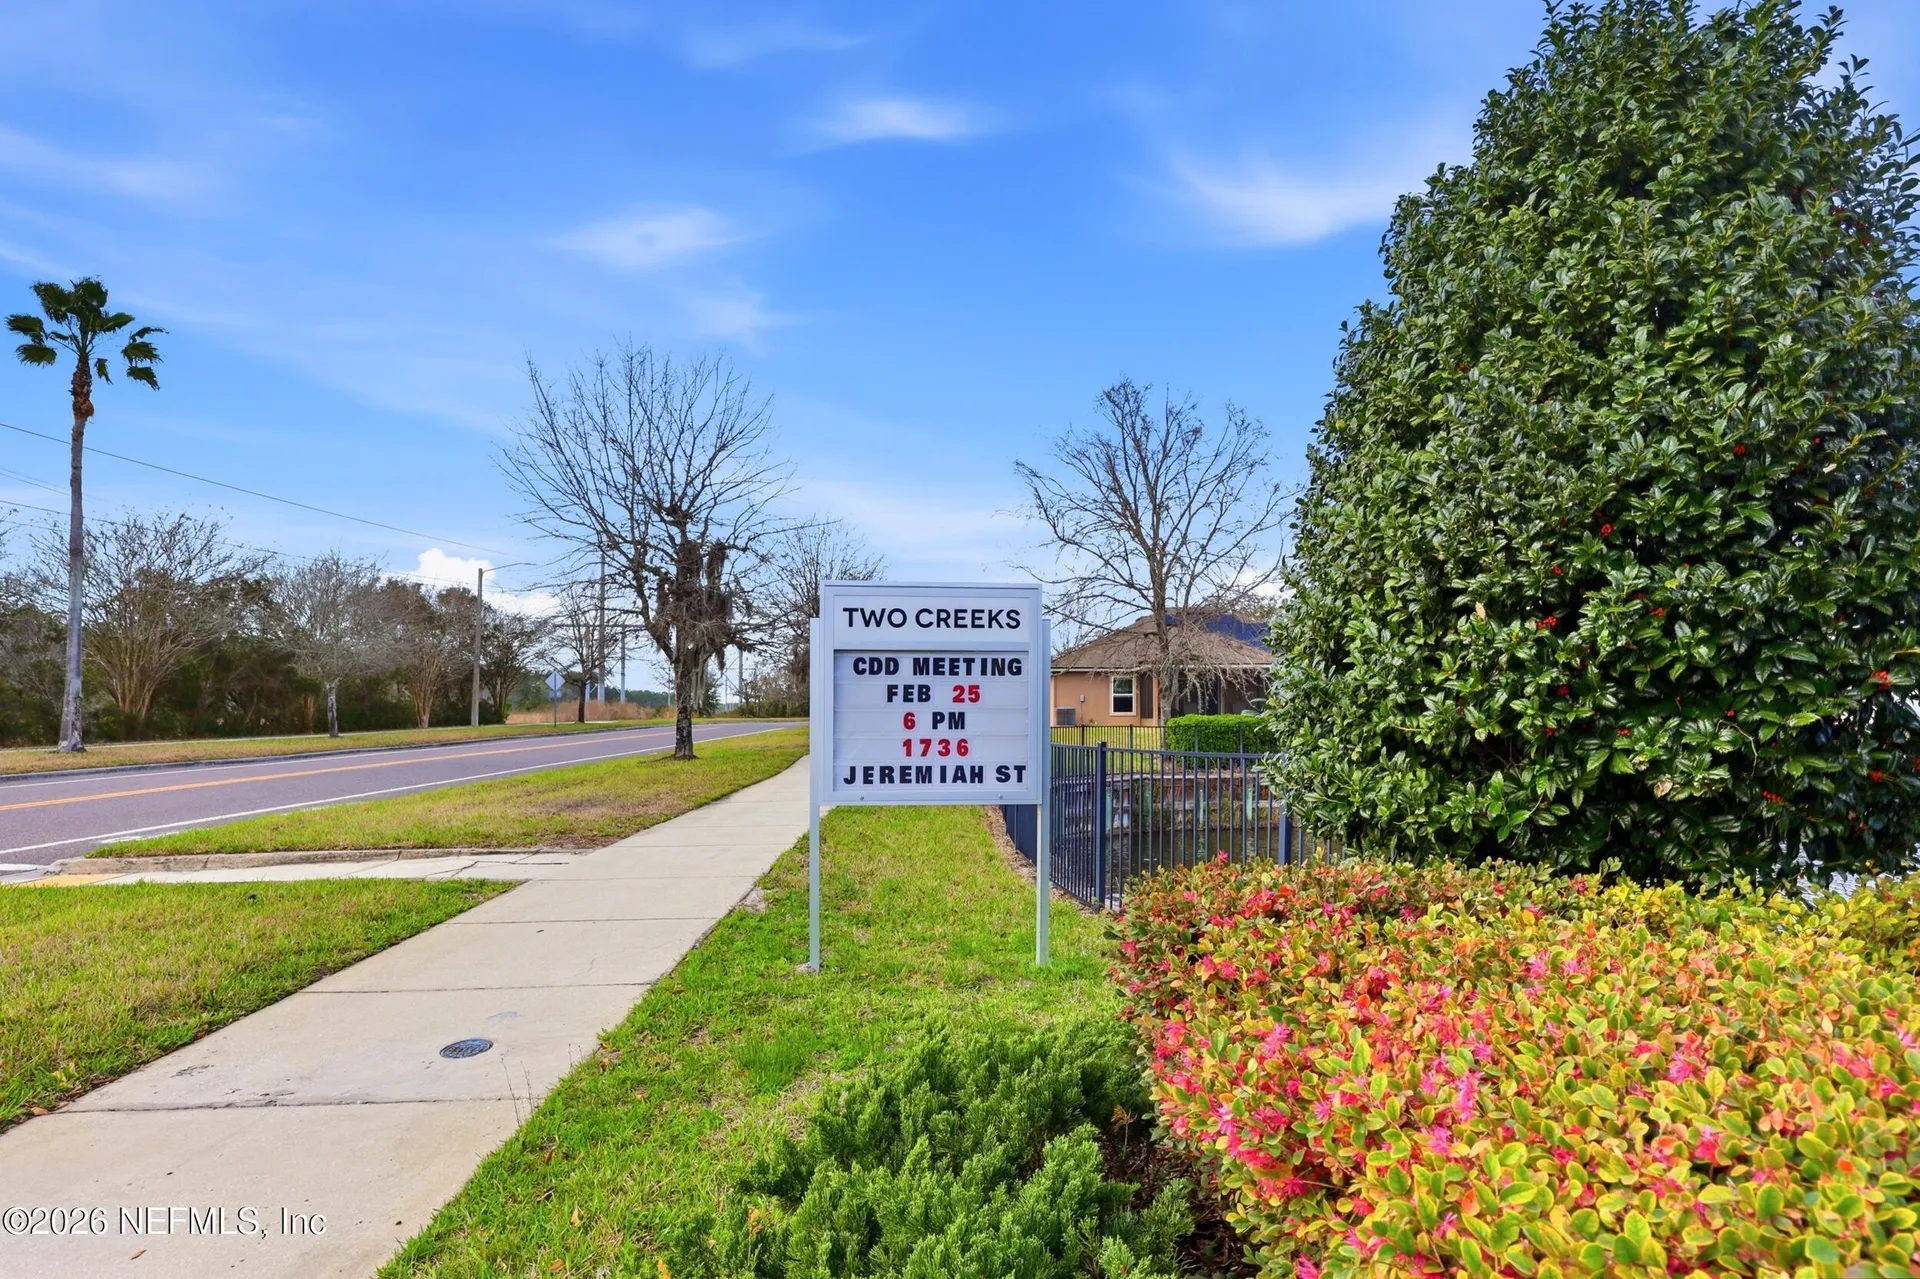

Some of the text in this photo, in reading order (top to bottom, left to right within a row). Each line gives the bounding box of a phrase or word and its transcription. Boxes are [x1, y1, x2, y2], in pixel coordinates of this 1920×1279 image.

[843, 608, 1021, 630] TWO CREEKS
[853, 656, 1022, 677] CDD MEETING
[887, 684, 981, 704] FEB 25
[903, 711, 965, 730] 6 PM
[902, 738, 969, 757] 1736
[843, 764, 1026, 785] JEREMIAH ST
